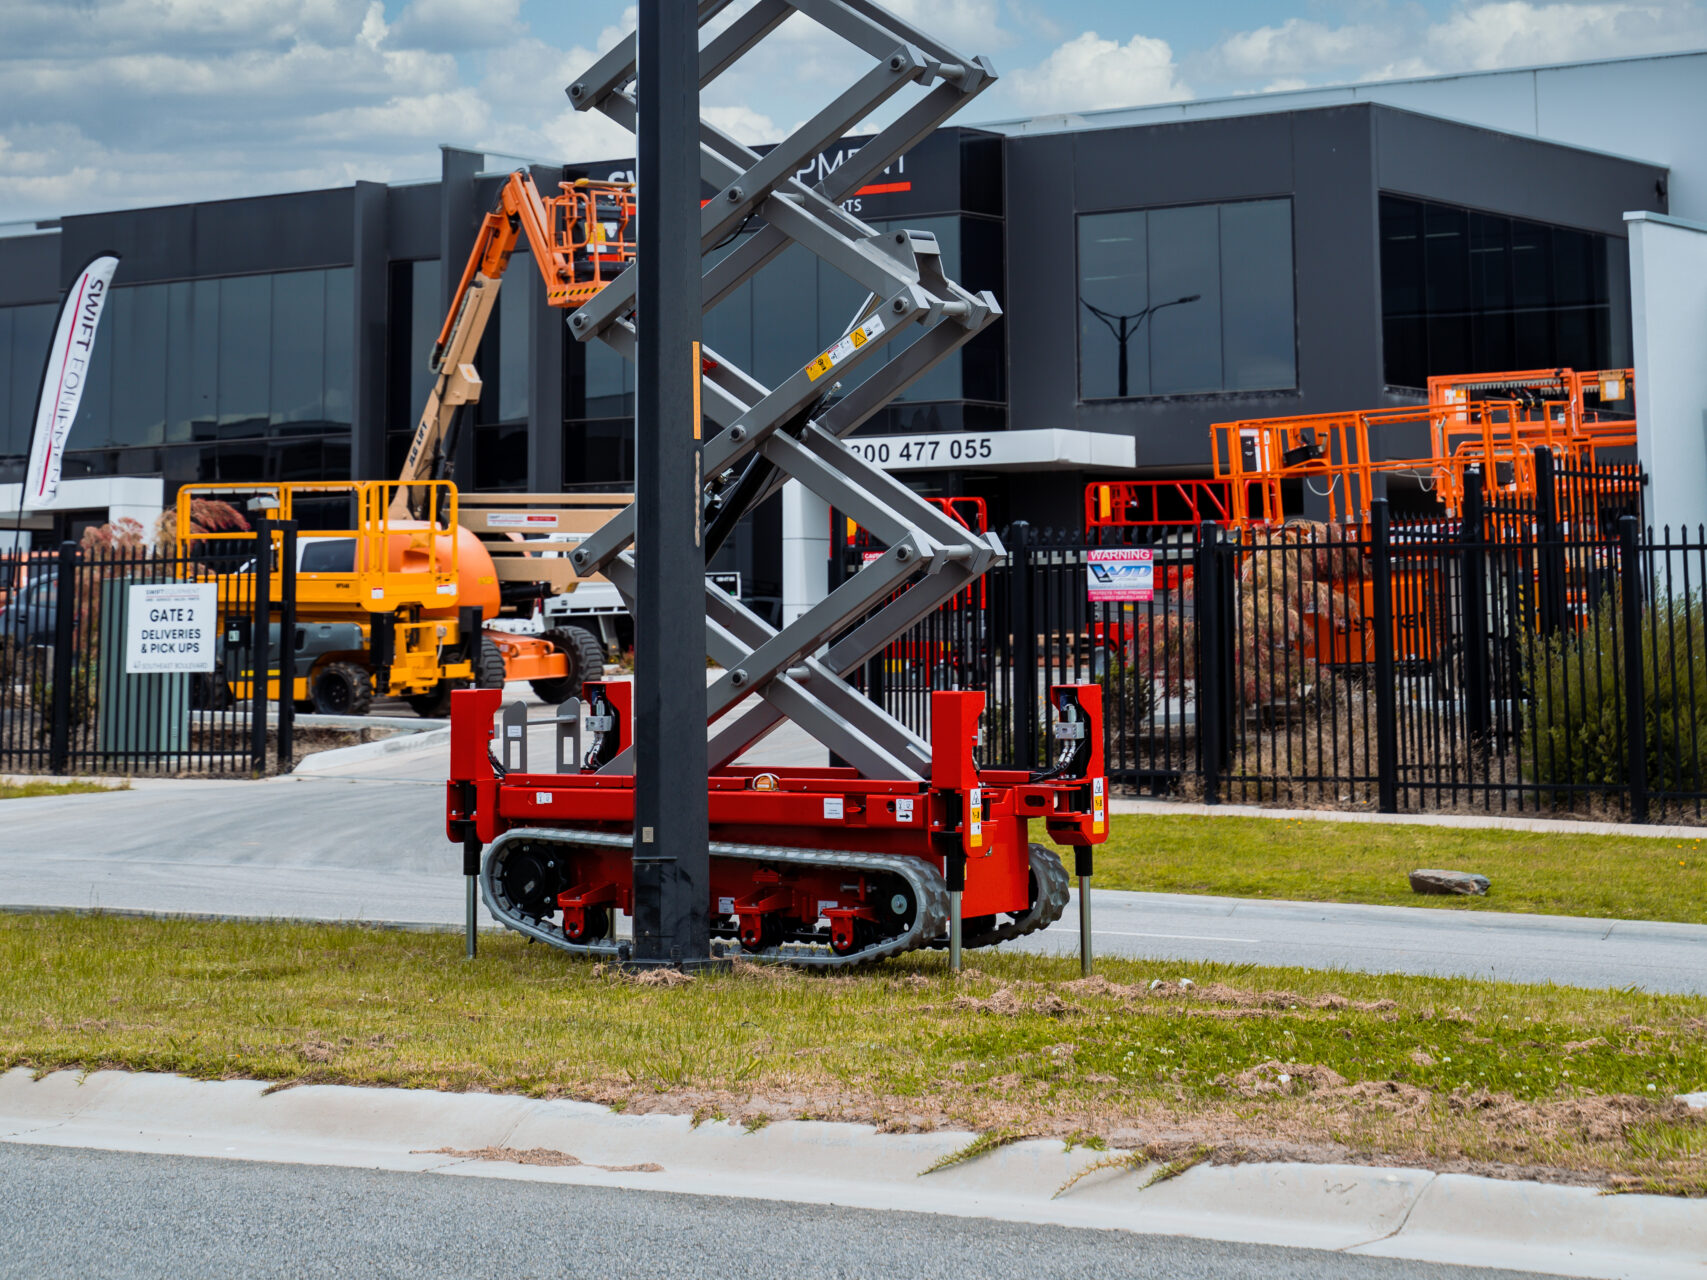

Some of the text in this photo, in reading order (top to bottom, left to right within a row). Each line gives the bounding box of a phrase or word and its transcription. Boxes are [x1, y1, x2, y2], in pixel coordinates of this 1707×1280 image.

[76, 278, 105, 352] SWIFT
[899, 441, 940, 461] 477
[950, 438, 991, 459] 055
[1091, 549, 1150, 560] WARNING
[150, 609, 194, 622] GATE 2
[141, 629, 201, 640] DELIVERIES
[141, 643, 200, 654] & PICK UPS
